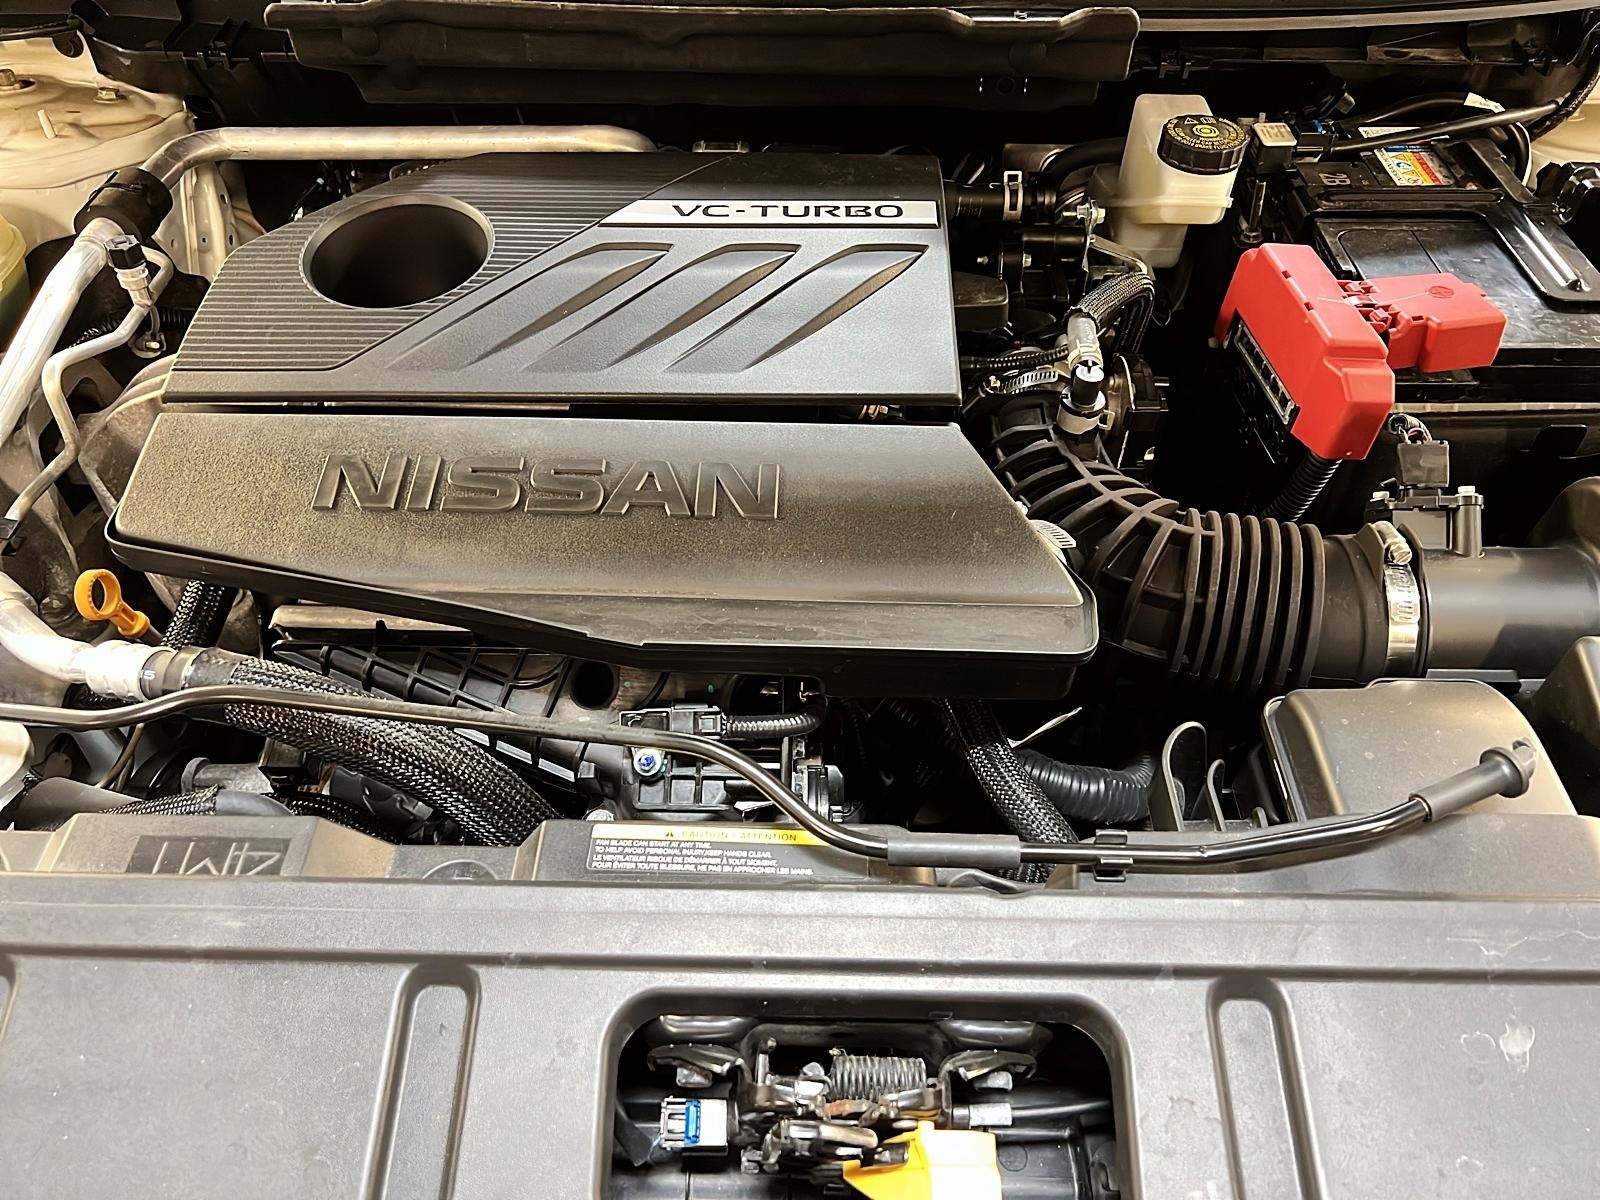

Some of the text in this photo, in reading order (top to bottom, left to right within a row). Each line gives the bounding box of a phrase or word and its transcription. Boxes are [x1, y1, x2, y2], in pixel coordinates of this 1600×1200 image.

[671, 204, 904, 218] VC-TURBO
[311, 453, 781, 519] NISSAN
[739, 832, 797, 841] ATTENTION
[610, 839, 632, 847] BLADE
[645, 847, 681, 855] PERSONAL
[603, 854, 646, 862] VENTILATEUR
[591, 861, 612, 869] POUR
[733, 866, 776, 874] APPROCHER
[776, 867, 790, 875] LES
